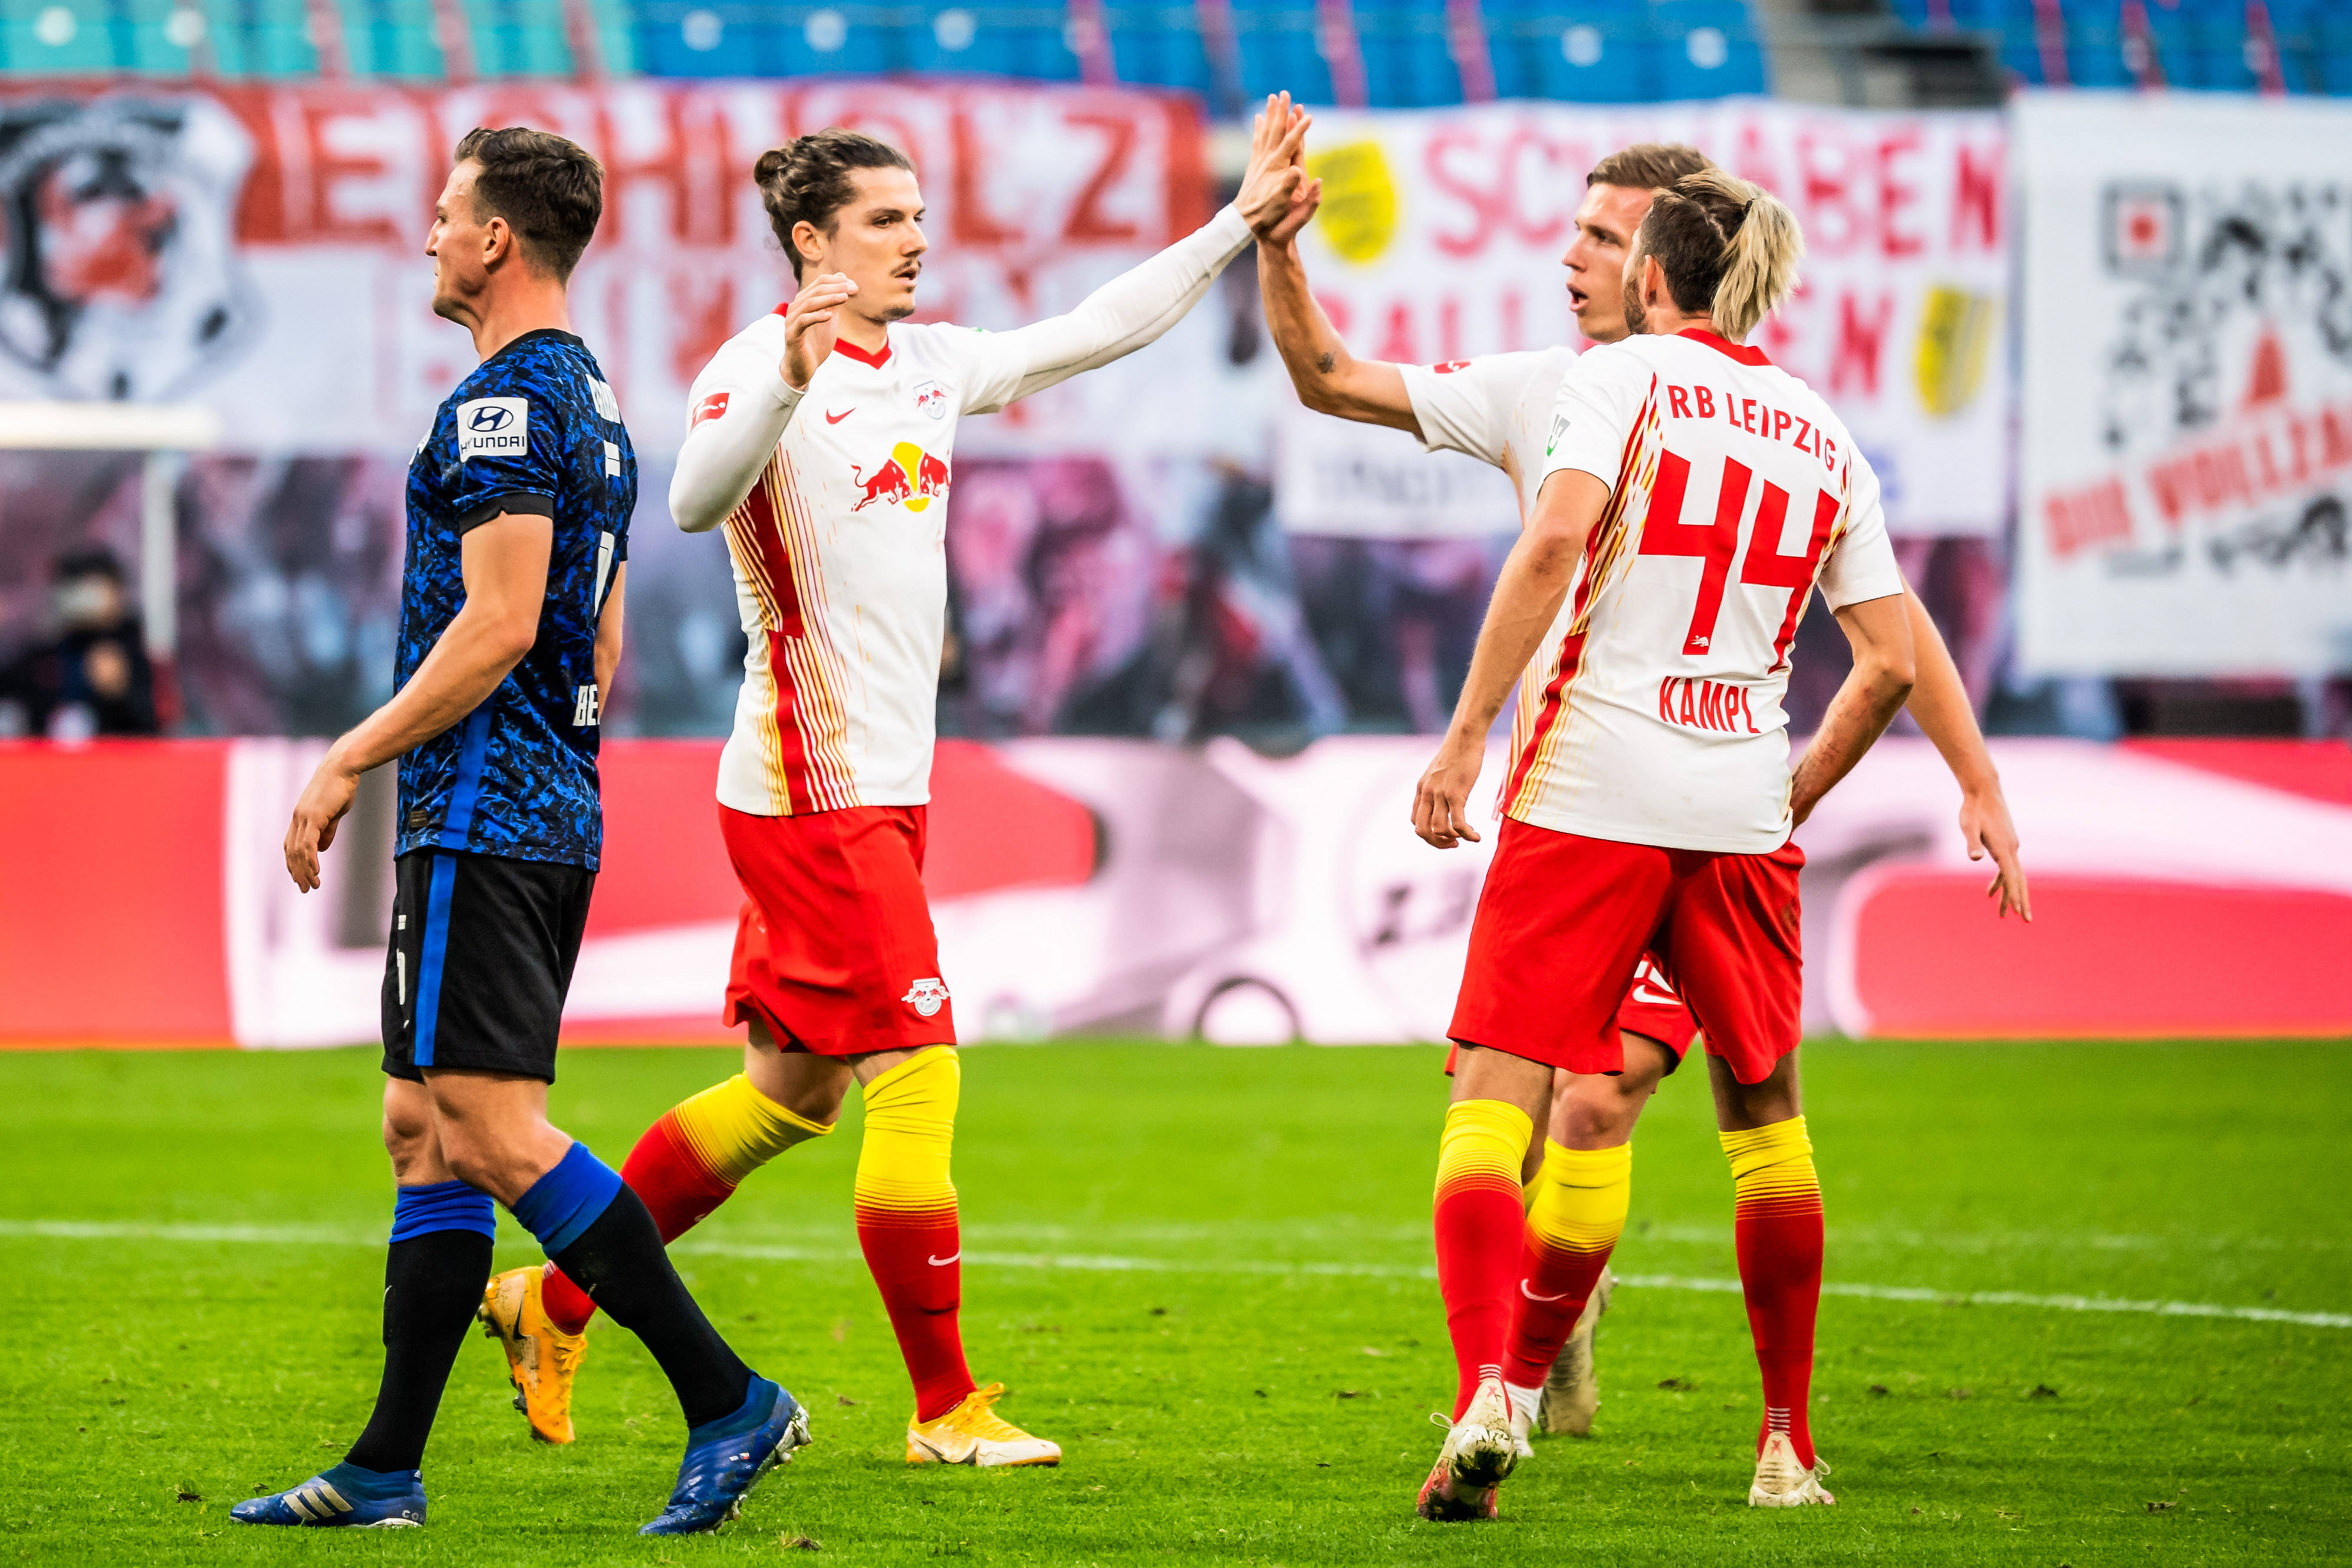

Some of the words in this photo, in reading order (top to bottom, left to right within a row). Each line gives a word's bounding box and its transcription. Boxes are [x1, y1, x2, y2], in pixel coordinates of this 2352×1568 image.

[1667, 385, 1716, 418] RB
[1726, 393, 1836, 472] LEIPZIG
[1637, 447, 1840, 676] 44
[1659, 676, 1762, 734] KAMPL
